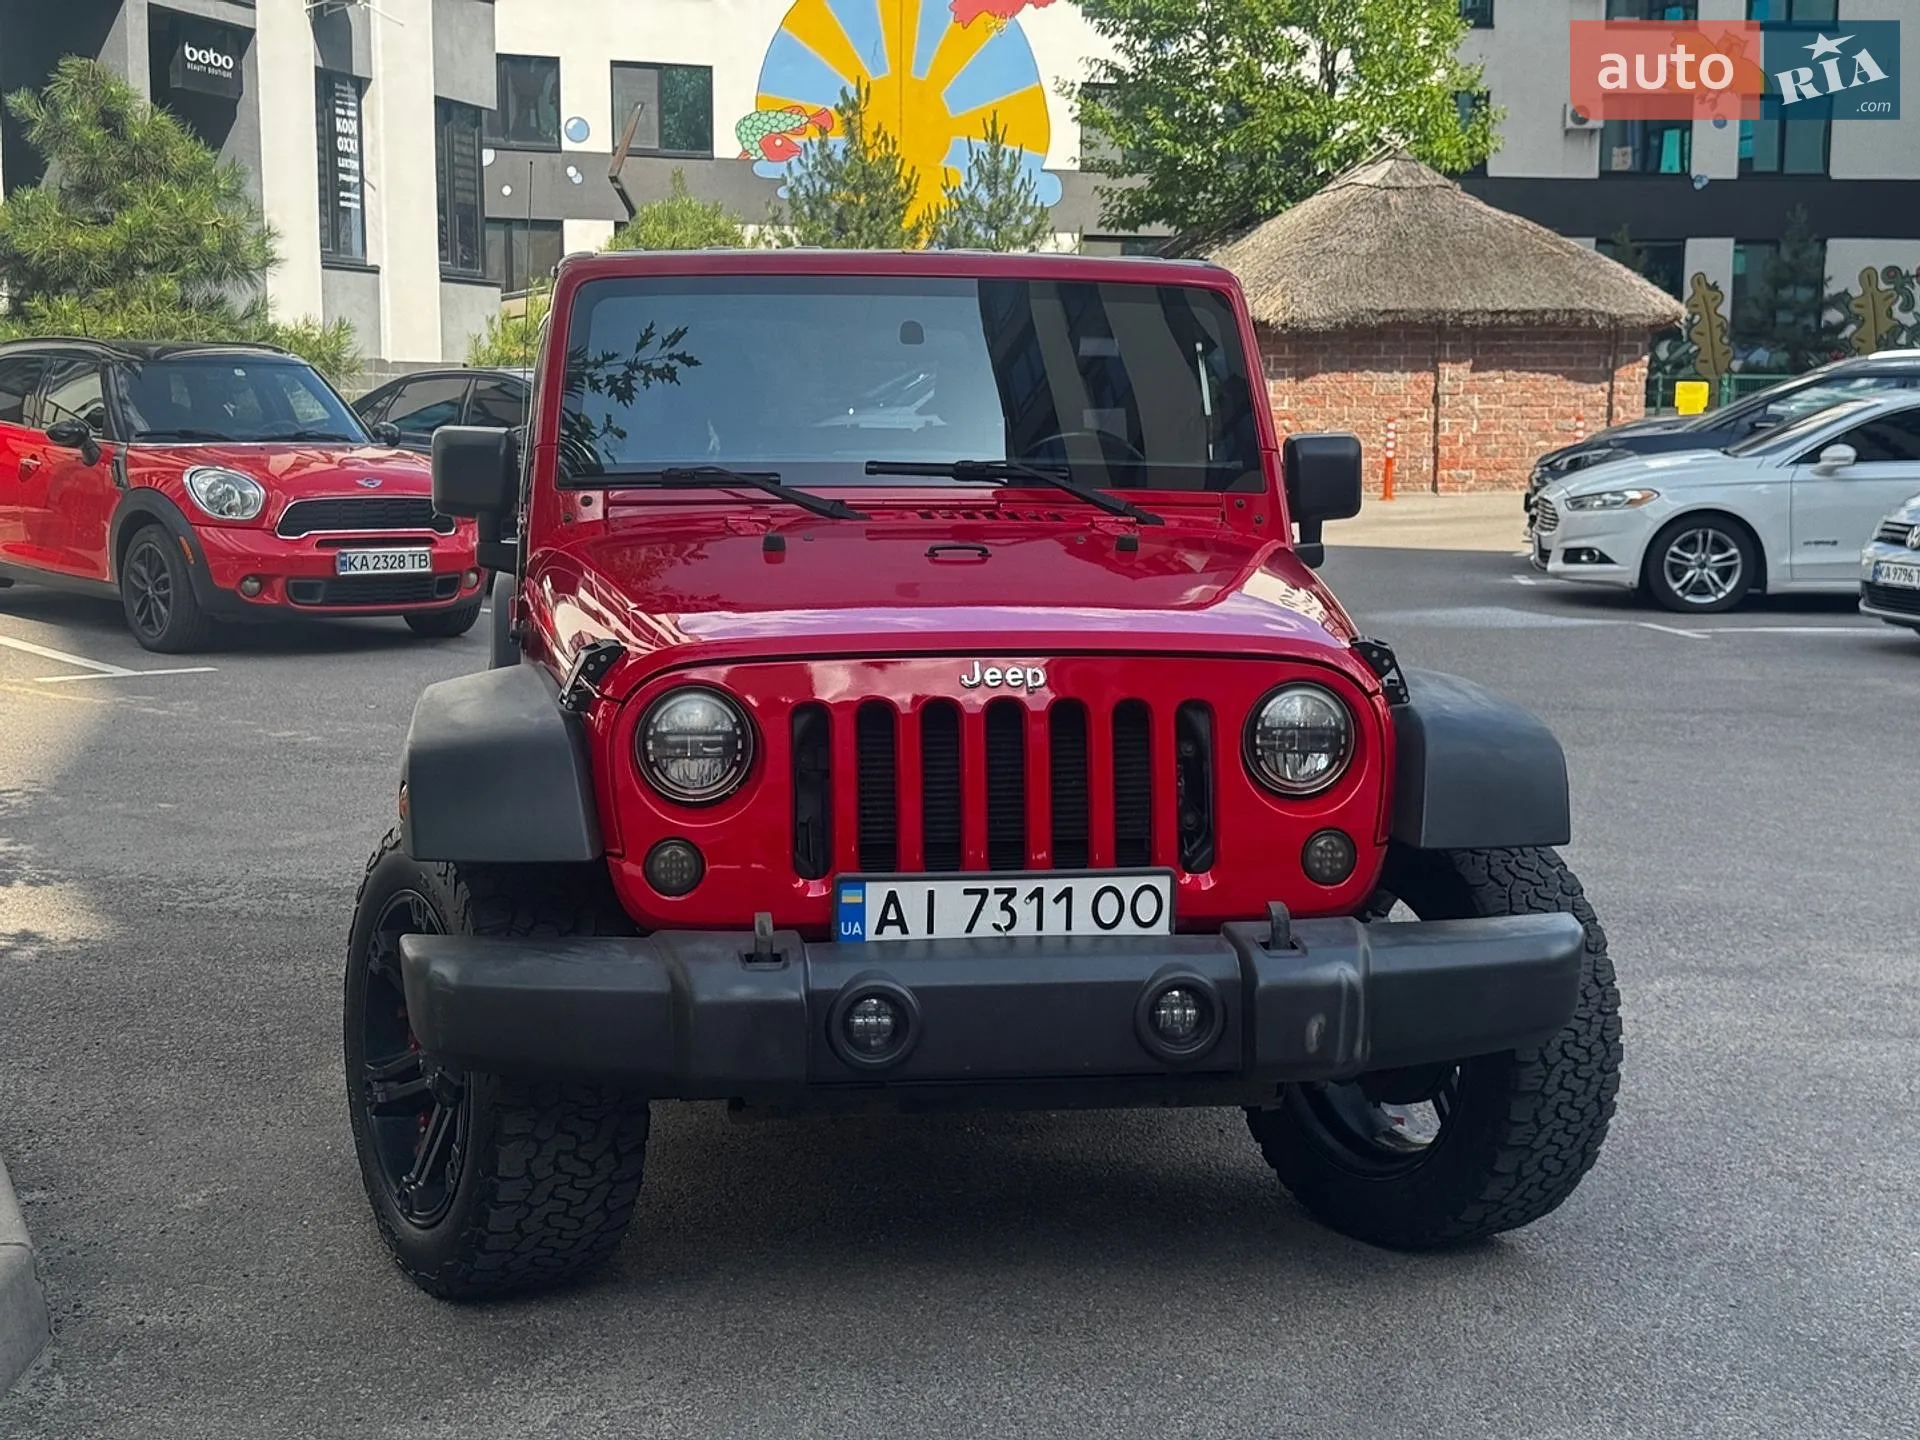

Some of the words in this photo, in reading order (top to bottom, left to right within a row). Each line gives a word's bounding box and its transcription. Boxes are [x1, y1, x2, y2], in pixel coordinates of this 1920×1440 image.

[184, 41, 234, 70] bobo
[348, 555, 370, 571] KA
[372, 554, 406, 570] 2328
[408, 553, 429, 569] TB
[960, 660, 1046, 695] Jeep
[963, 886, 1074, 934] 7311
[841, 921, 863, 935] UA
